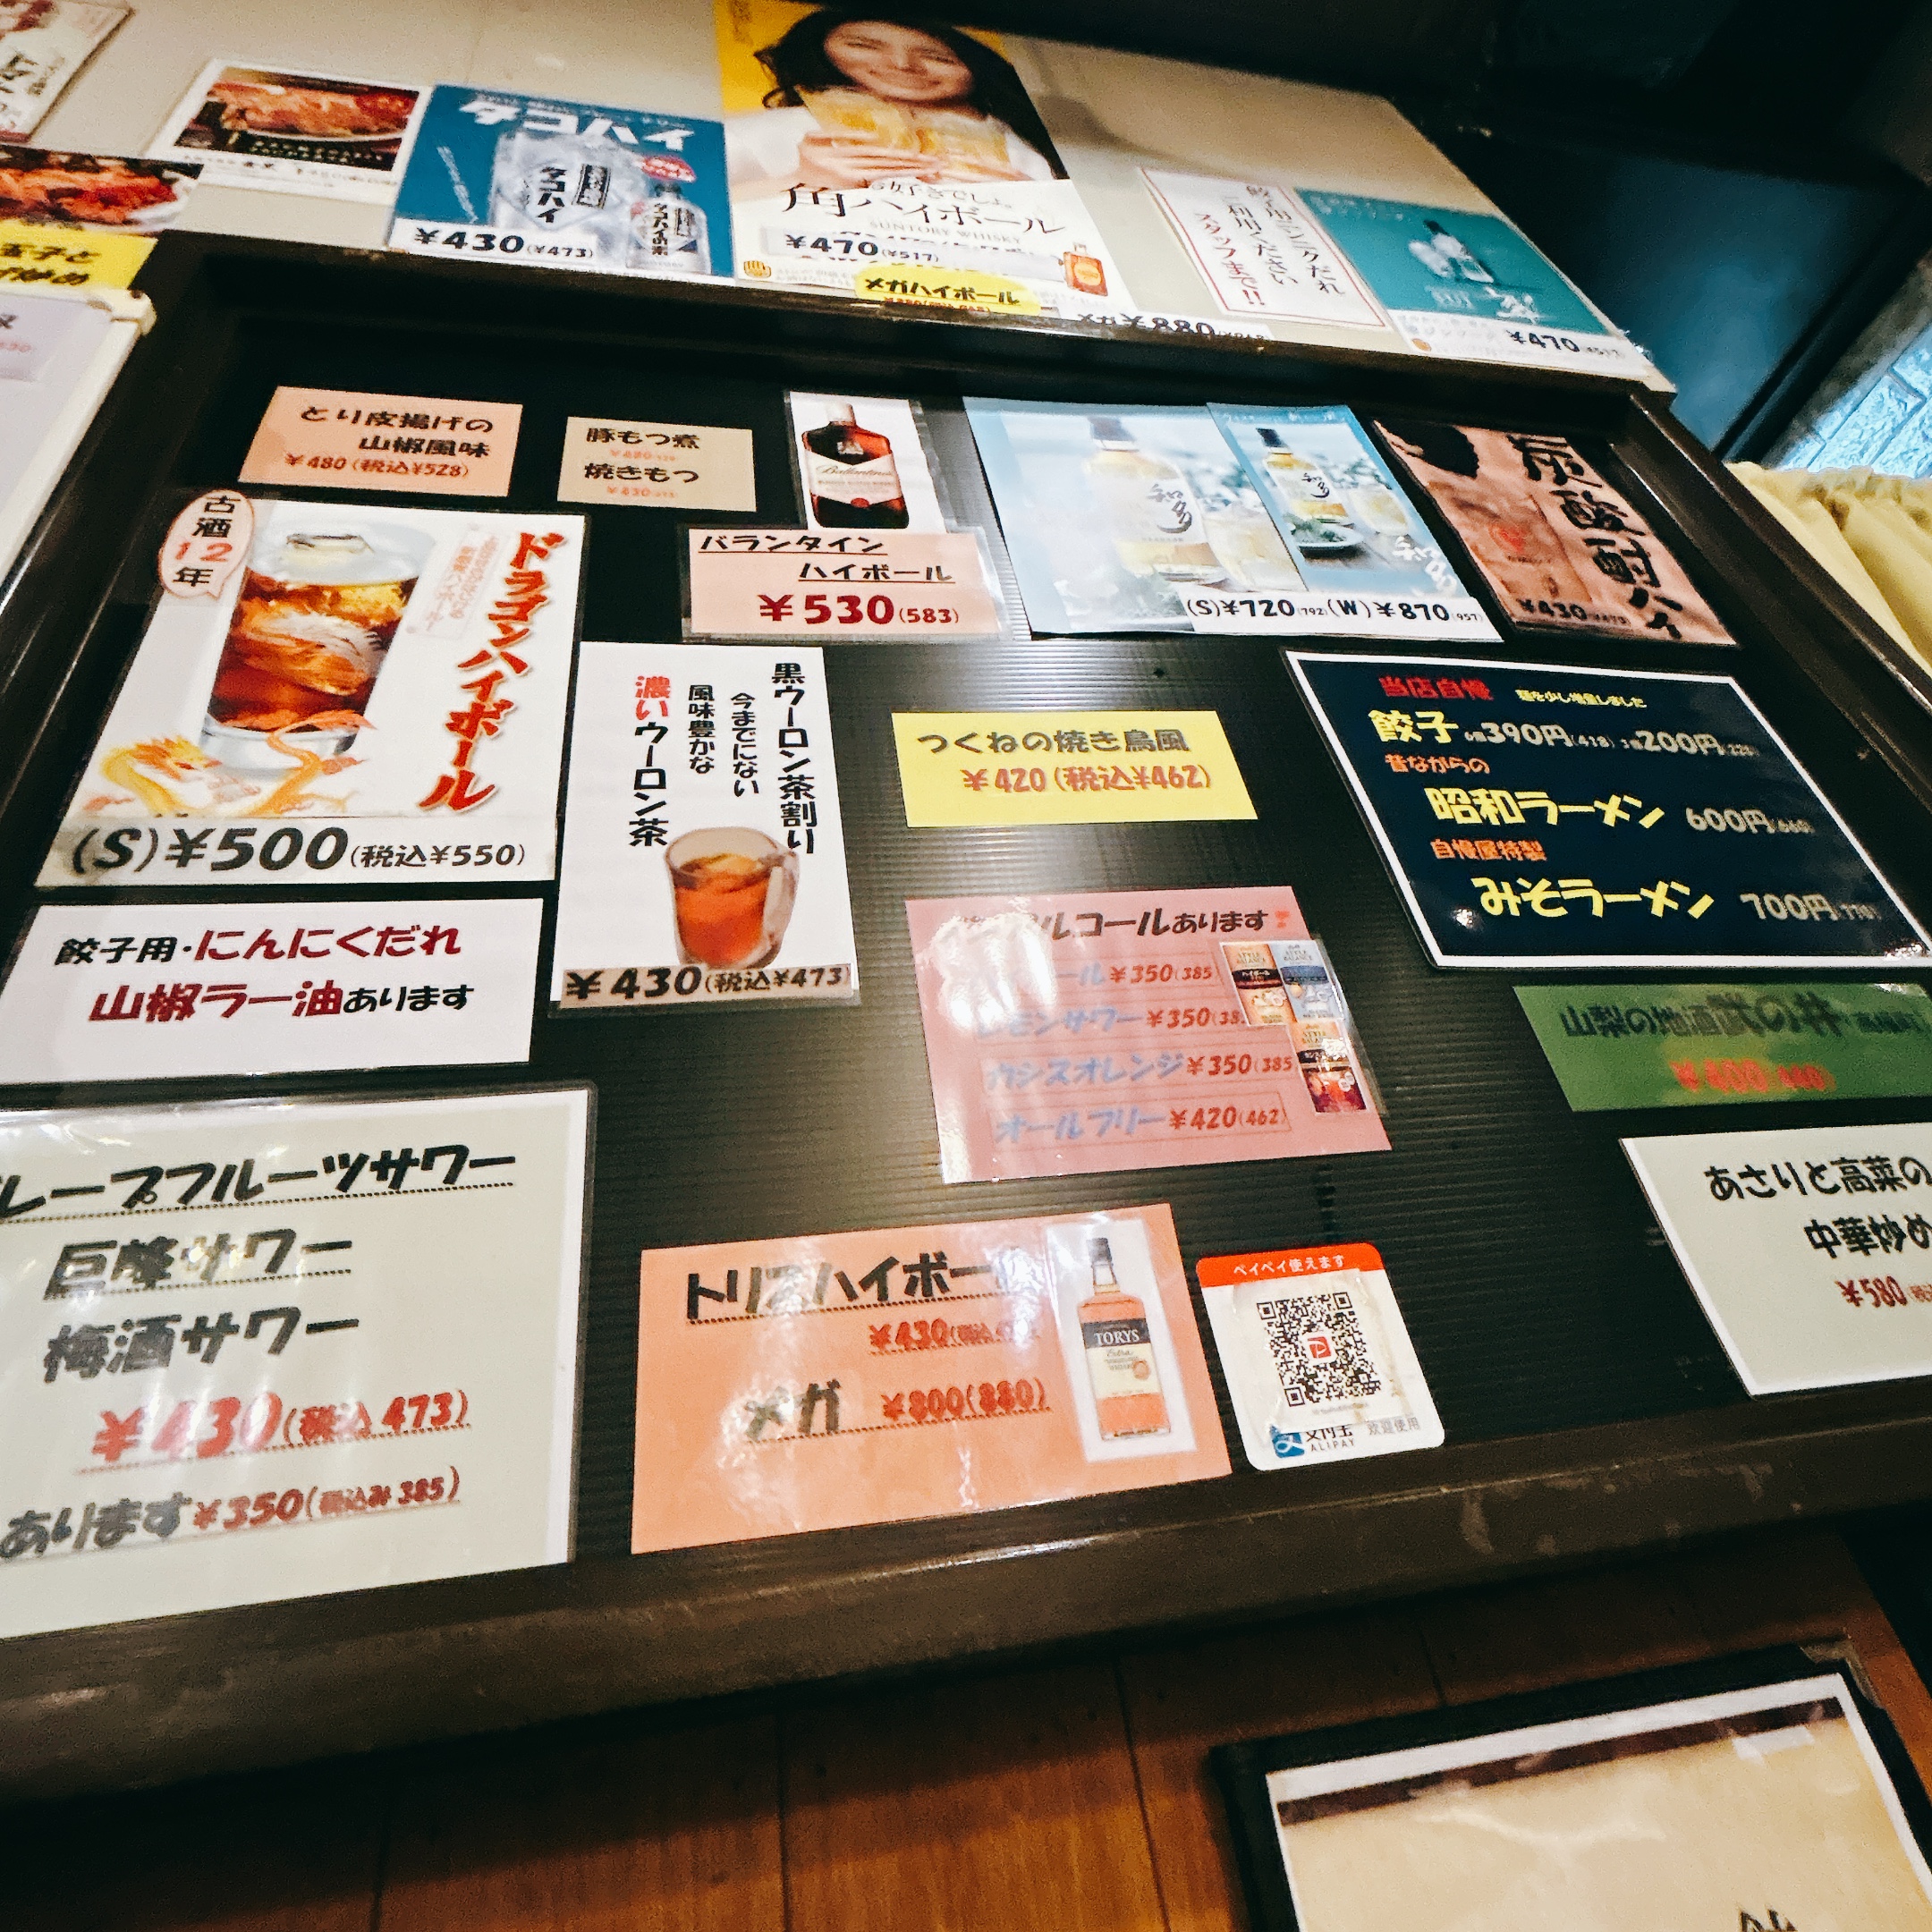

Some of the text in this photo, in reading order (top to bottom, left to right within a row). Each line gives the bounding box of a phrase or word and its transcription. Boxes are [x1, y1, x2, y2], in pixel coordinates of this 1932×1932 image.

[865, 276, 1021, 306] メガハイボール
[301, 404, 494, 433] とり皮揚げの
[358, 436, 491, 458] 山椒風味
[584, 462, 699, 483] 焼きもつ
[700, 534, 884, 553] バランタイン
[799, 563, 953, 582] ハイボール
[418, 531, 565, 813] ドラゴンハイボール
[688, 684, 715, 775] 風味豊かな
[730, 692, 759, 797] 今までにない
[918, 729, 1191, 755] つくねの焼き鳥風
[629, 675, 673, 847] 濃いウーロン茶
[772, 662, 818, 854] 黒ウーロン茶割り
[1424, 787, 1665, 828] 昭和ラーメン
[1471, 877, 1715, 920] みそラーメン
[0, 1144, 516, 1219] レープフルーツサワー
[1705, 1154, 1932, 1201] あさりと高菜の
[1233, 1254, 1345, 1276] ペイペイ使えます
[1094, 1328, 1141, 1347] TORYS
[1310, 1438, 1356, 1453] ALIPAY
